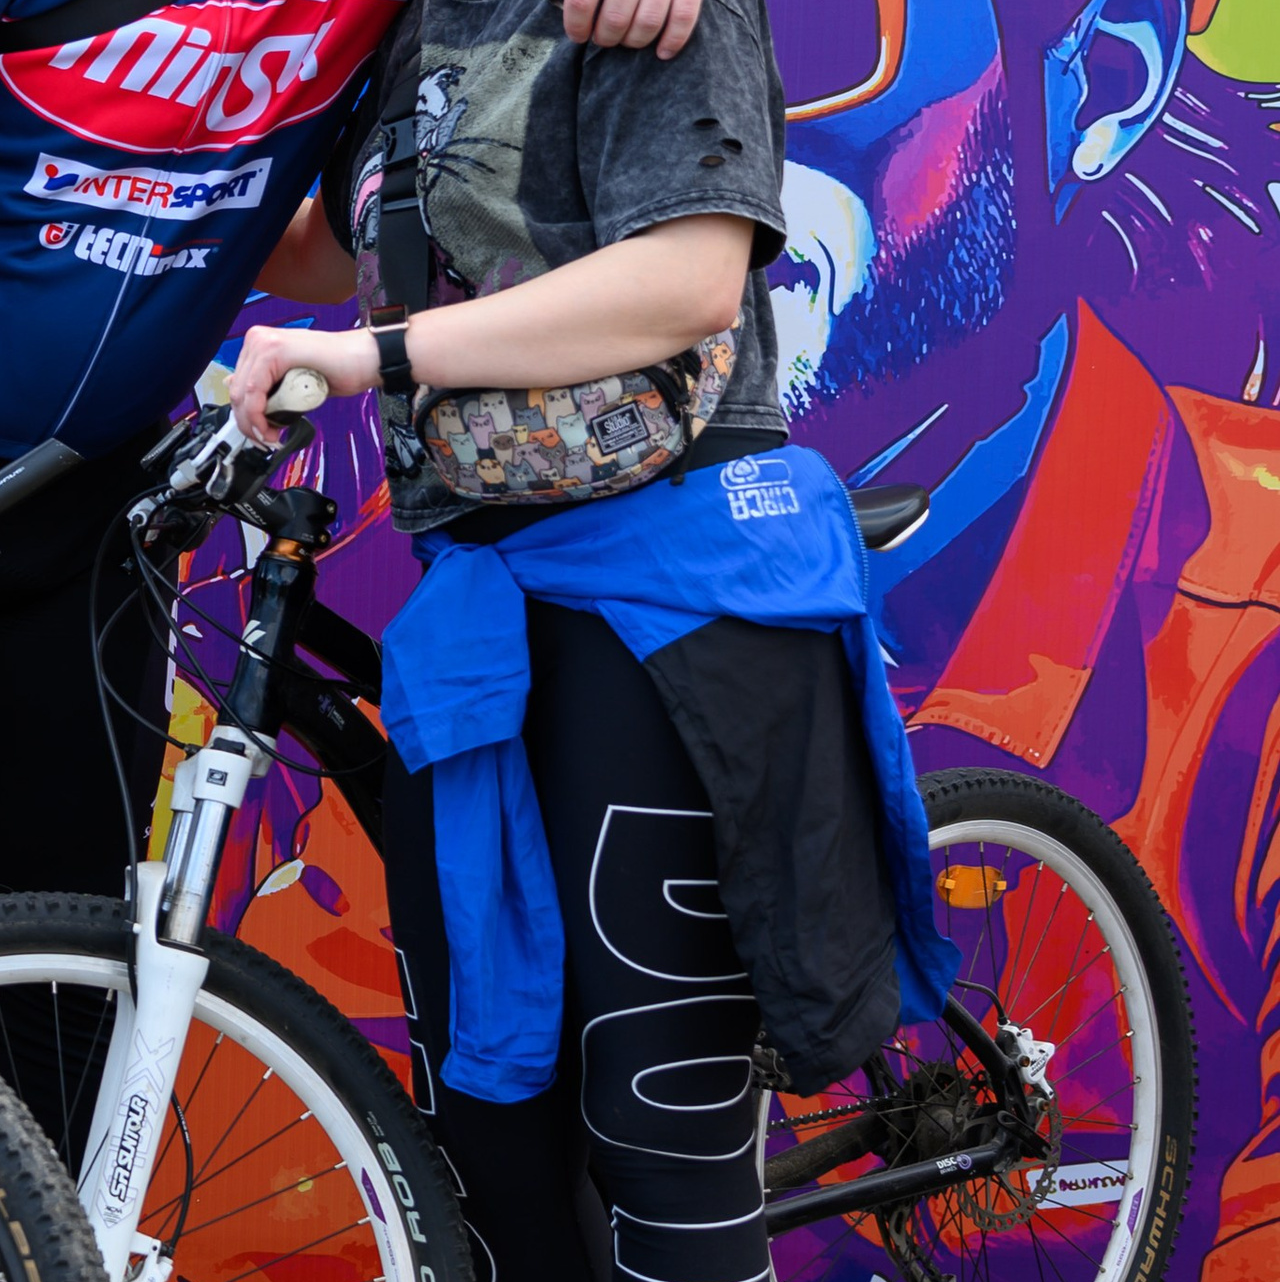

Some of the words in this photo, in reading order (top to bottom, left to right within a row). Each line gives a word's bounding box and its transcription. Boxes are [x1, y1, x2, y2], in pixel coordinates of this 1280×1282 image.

[73, 169, 258, 209] INTERSPORT
[727, 486, 800, 521] CIRCA
[936, 1156, 958, 1169] DISC
[377, 1141, 427, 1245] ROB
